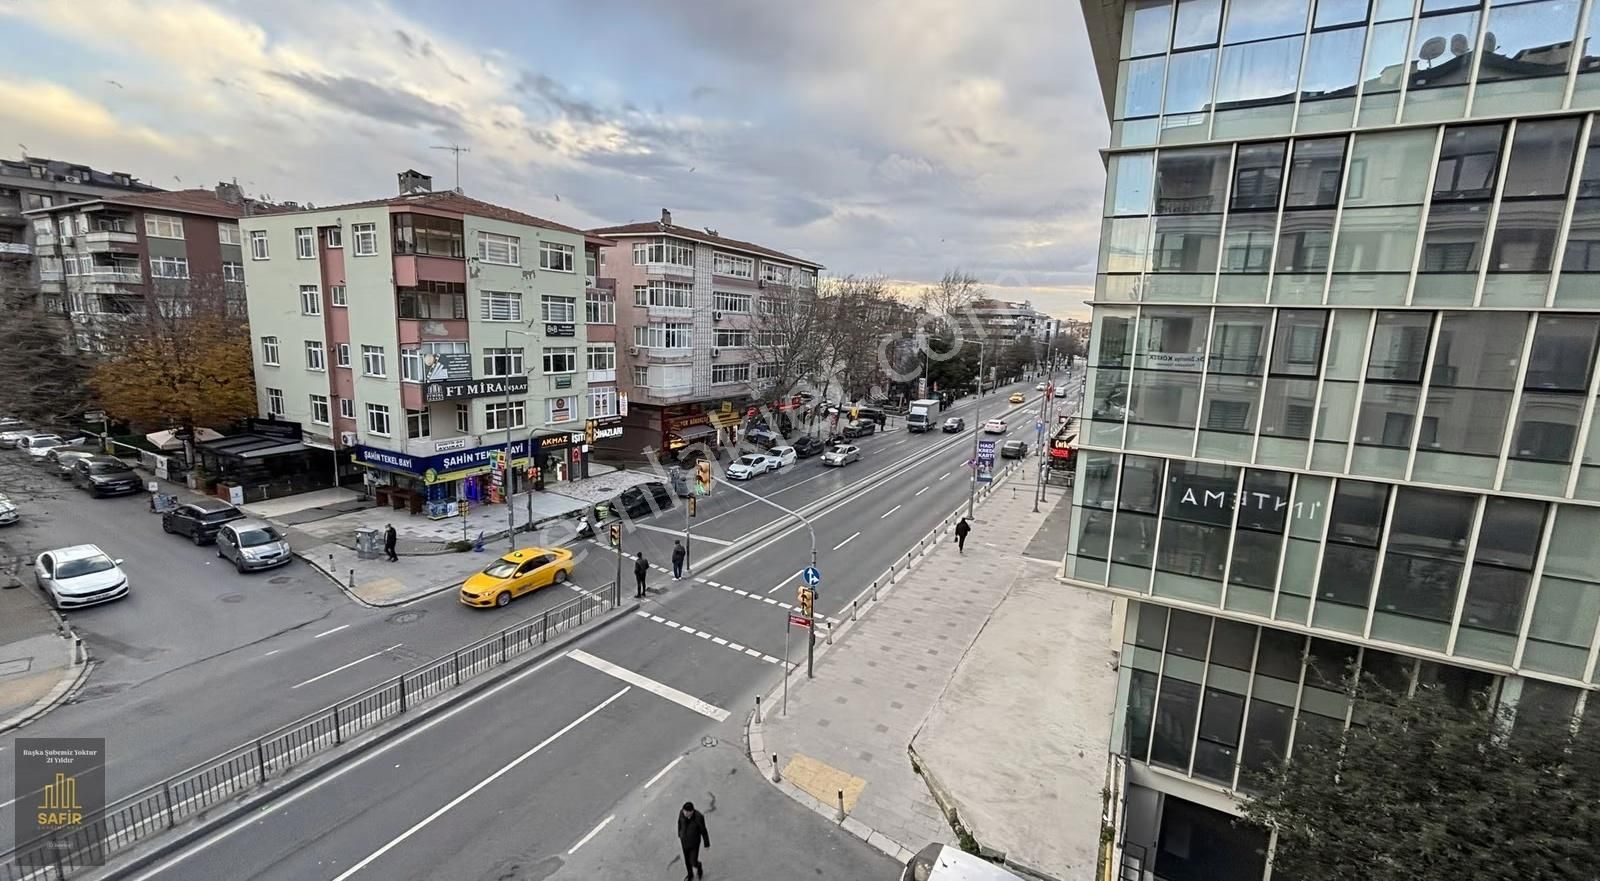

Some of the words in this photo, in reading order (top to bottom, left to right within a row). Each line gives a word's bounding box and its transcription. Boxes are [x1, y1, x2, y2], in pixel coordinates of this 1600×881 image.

[446, 386, 463, 396] FT
[467, 382, 503, 395] MİRA
[541, 435, 568, 446] AKMAZ
[364, 450, 381, 462] ŞAHİN
[380, 454, 398, 465] TEKEL
[443, 453, 474, 469] ŞAHİN
